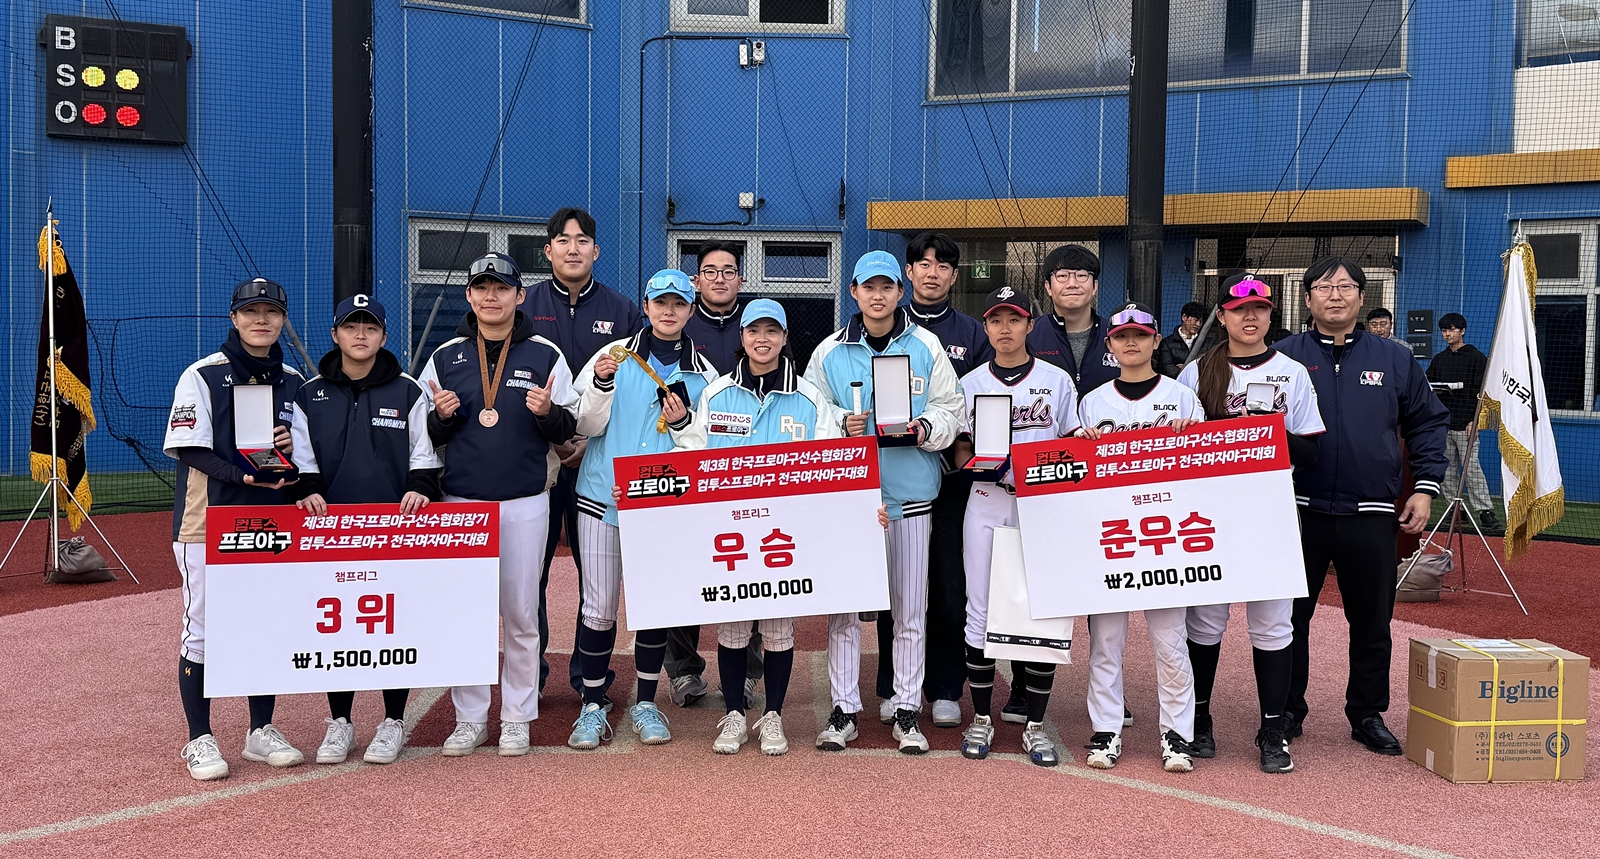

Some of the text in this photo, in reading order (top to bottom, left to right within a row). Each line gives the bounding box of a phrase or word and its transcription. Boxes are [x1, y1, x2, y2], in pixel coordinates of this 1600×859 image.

[55, 26, 76, 50] B
[56, 63, 76, 87] S
[55, 100, 78, 124] O
[353, 294, 369, 307] C
[1265, 375, 1291, 384] BLACK
[1153, 404, 1178, 412] BLACK
[1096, 426, 1273, 457] 제3회 한국프로야구선수협회장기
[698, 446, 867, 473] 제3회 한국프로야구선수협회장기
[1036, 450, 1075, 463] 컴투스
[1095, 445, 1276, 478] 컴투스프로야구 전국여자야구대회
[638, 464, 677, 477] 컴투스
[697, 466, 868, 493] 컴투스프로야구 전국여자야구대회
[1025, 461, 1089, 484] 프로야구
[627, 476, 691, 497] 프로야구
[1132, 492, 1172, 505] 챔프리그
[235, 517, 278, 531] 컴투스
[302, 513, 489, 530] 제3회 한국프로야구선수협회장기
[731, 508, 770, 520] 챔프리그
[218, 531, 292, 551] 프로야구
[299, 532, 489, 550] 컴투스프로야구 전국여자야구대회
[1100, 511, 1216, 560] 준우승
[335, 571, 378, 582] 챔프리그
[1104, 564, 1222, 590] ₩2,000,000
[701, 578, 813, 603] ₩3,000,000
[292, 647, 418, 671] ₩1,500,000
[1478, 680, 1559, 704] Bigline
[1517, 732, 1540, 740] 스포츠
